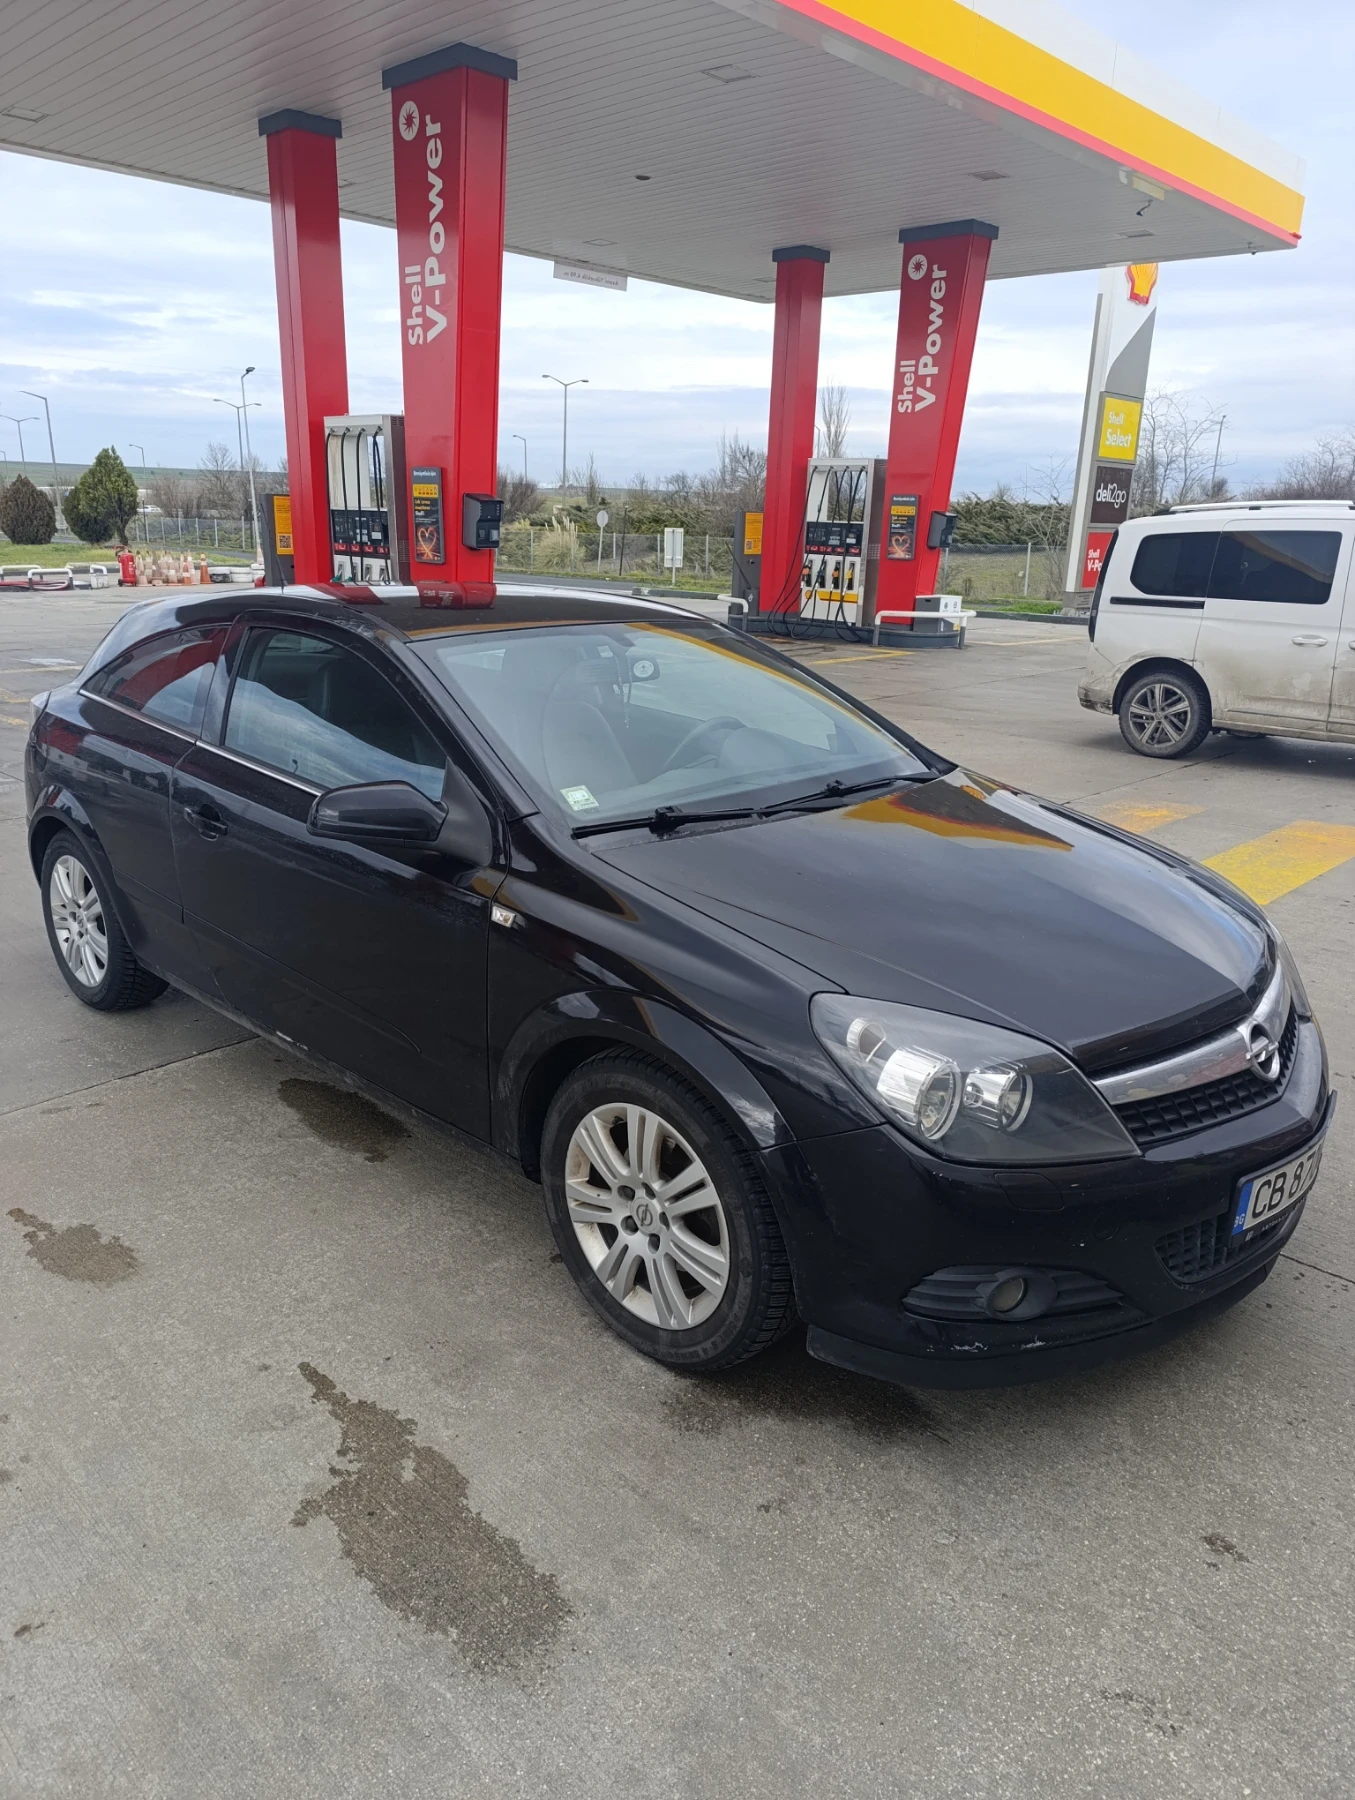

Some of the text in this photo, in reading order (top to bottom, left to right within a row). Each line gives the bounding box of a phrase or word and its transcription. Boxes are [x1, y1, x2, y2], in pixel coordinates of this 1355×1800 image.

[425, 114, 447, 343] V-Power
[405, 265, 424, 345] Shell
[915, 264, 947, 413] V-Power
[897, 360, 916, 413] Shell
[1108, 411, 1125, 425] Shell
[1105, 428, 1132, 448] Select
[1096, 483, 1127, 508] deli2go
[1087, 559, 1102, 572] V-Po
[1088, 549, 1100, 558] Shell
[1252, 1147, 1318, 1219] CB 87
